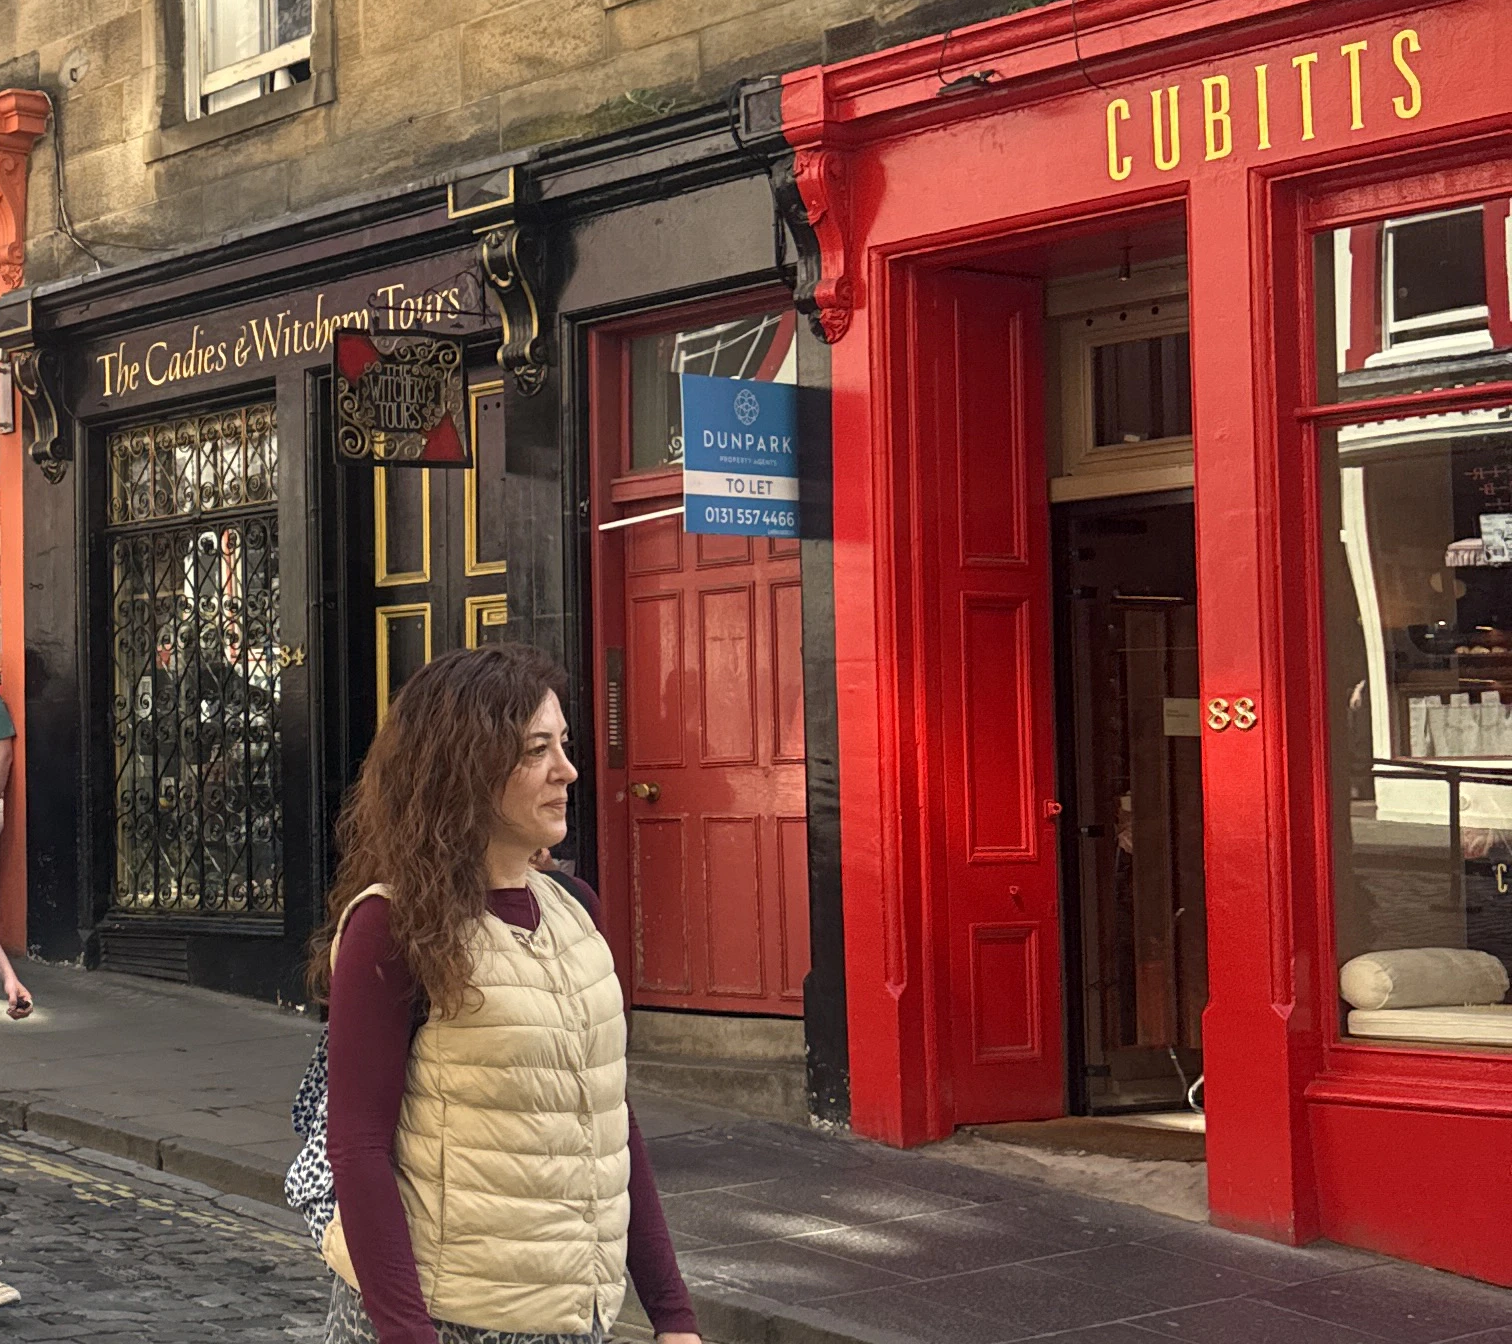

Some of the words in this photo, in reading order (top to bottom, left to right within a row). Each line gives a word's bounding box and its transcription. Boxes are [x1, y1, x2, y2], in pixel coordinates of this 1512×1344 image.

[1106, 29, 1422, 181] CUBITTS
[96, 342, 140, 397] The
[145, 325, 227, 386] Cadies
[234, 325, 252, 367] &
[377, 283, 461, 330] Tours
[384, 364, 412, 376] THE
[369, 374, 429, 403] WITCHERY
[374, 402, 422, 429] TOURS
[703, 430, 793, 454] DUNPARK
[719, 456, 752, 464] PROPERTY
[726, 478, 745, 493] TO
[749, 480, 773, 495] LET
[705, 506, 733, 524] 0131
[737, 508, 760, 525] 557
[762, 510, 795, 527] 4466
[1208, 697, 1257, 730] 88
